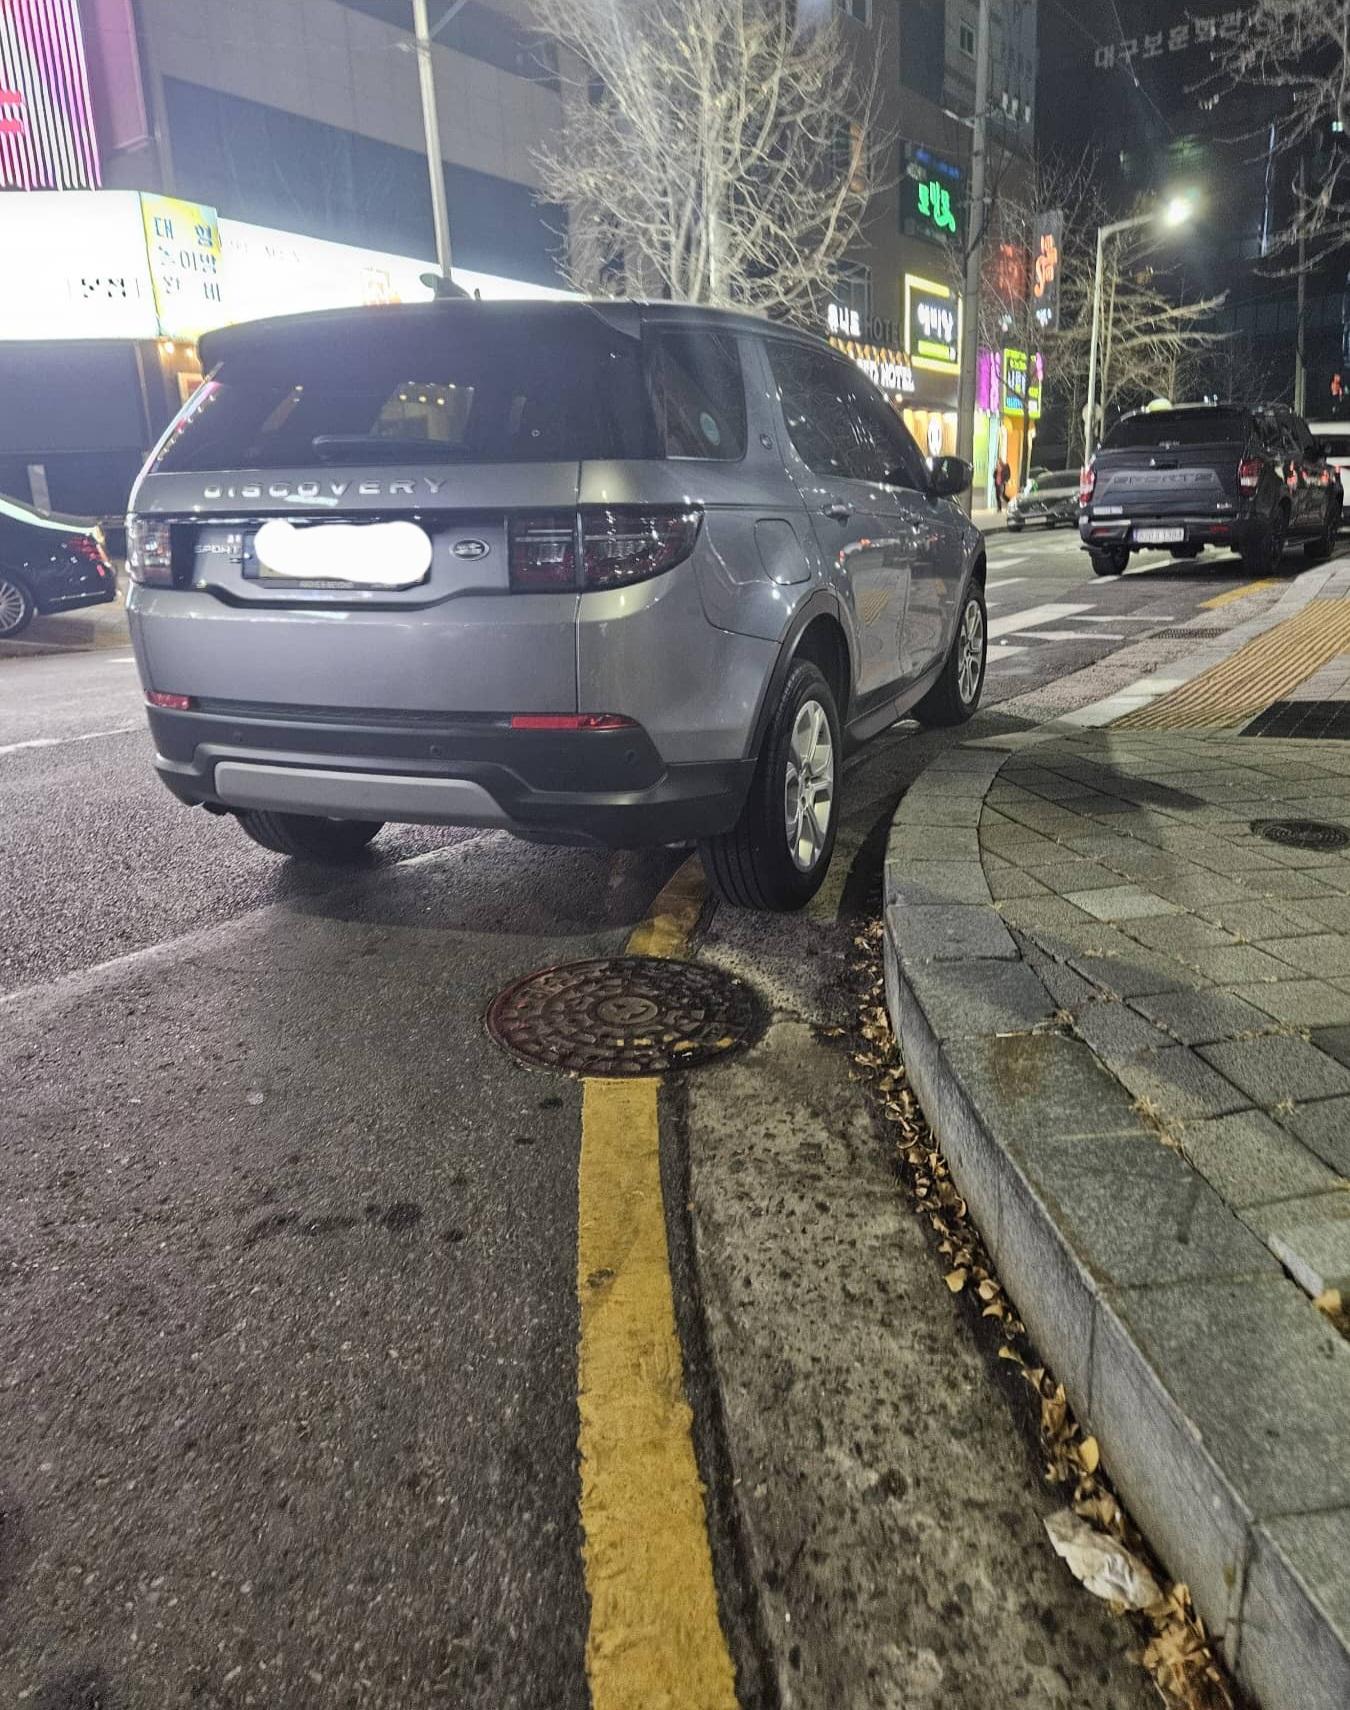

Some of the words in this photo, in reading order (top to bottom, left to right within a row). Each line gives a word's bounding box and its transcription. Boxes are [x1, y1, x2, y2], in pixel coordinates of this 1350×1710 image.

[863, 314, 900, 348] HOTE
[880, 362, 915, 391] HOTEL
[203, 477, 447, 500] DISCOVERY
